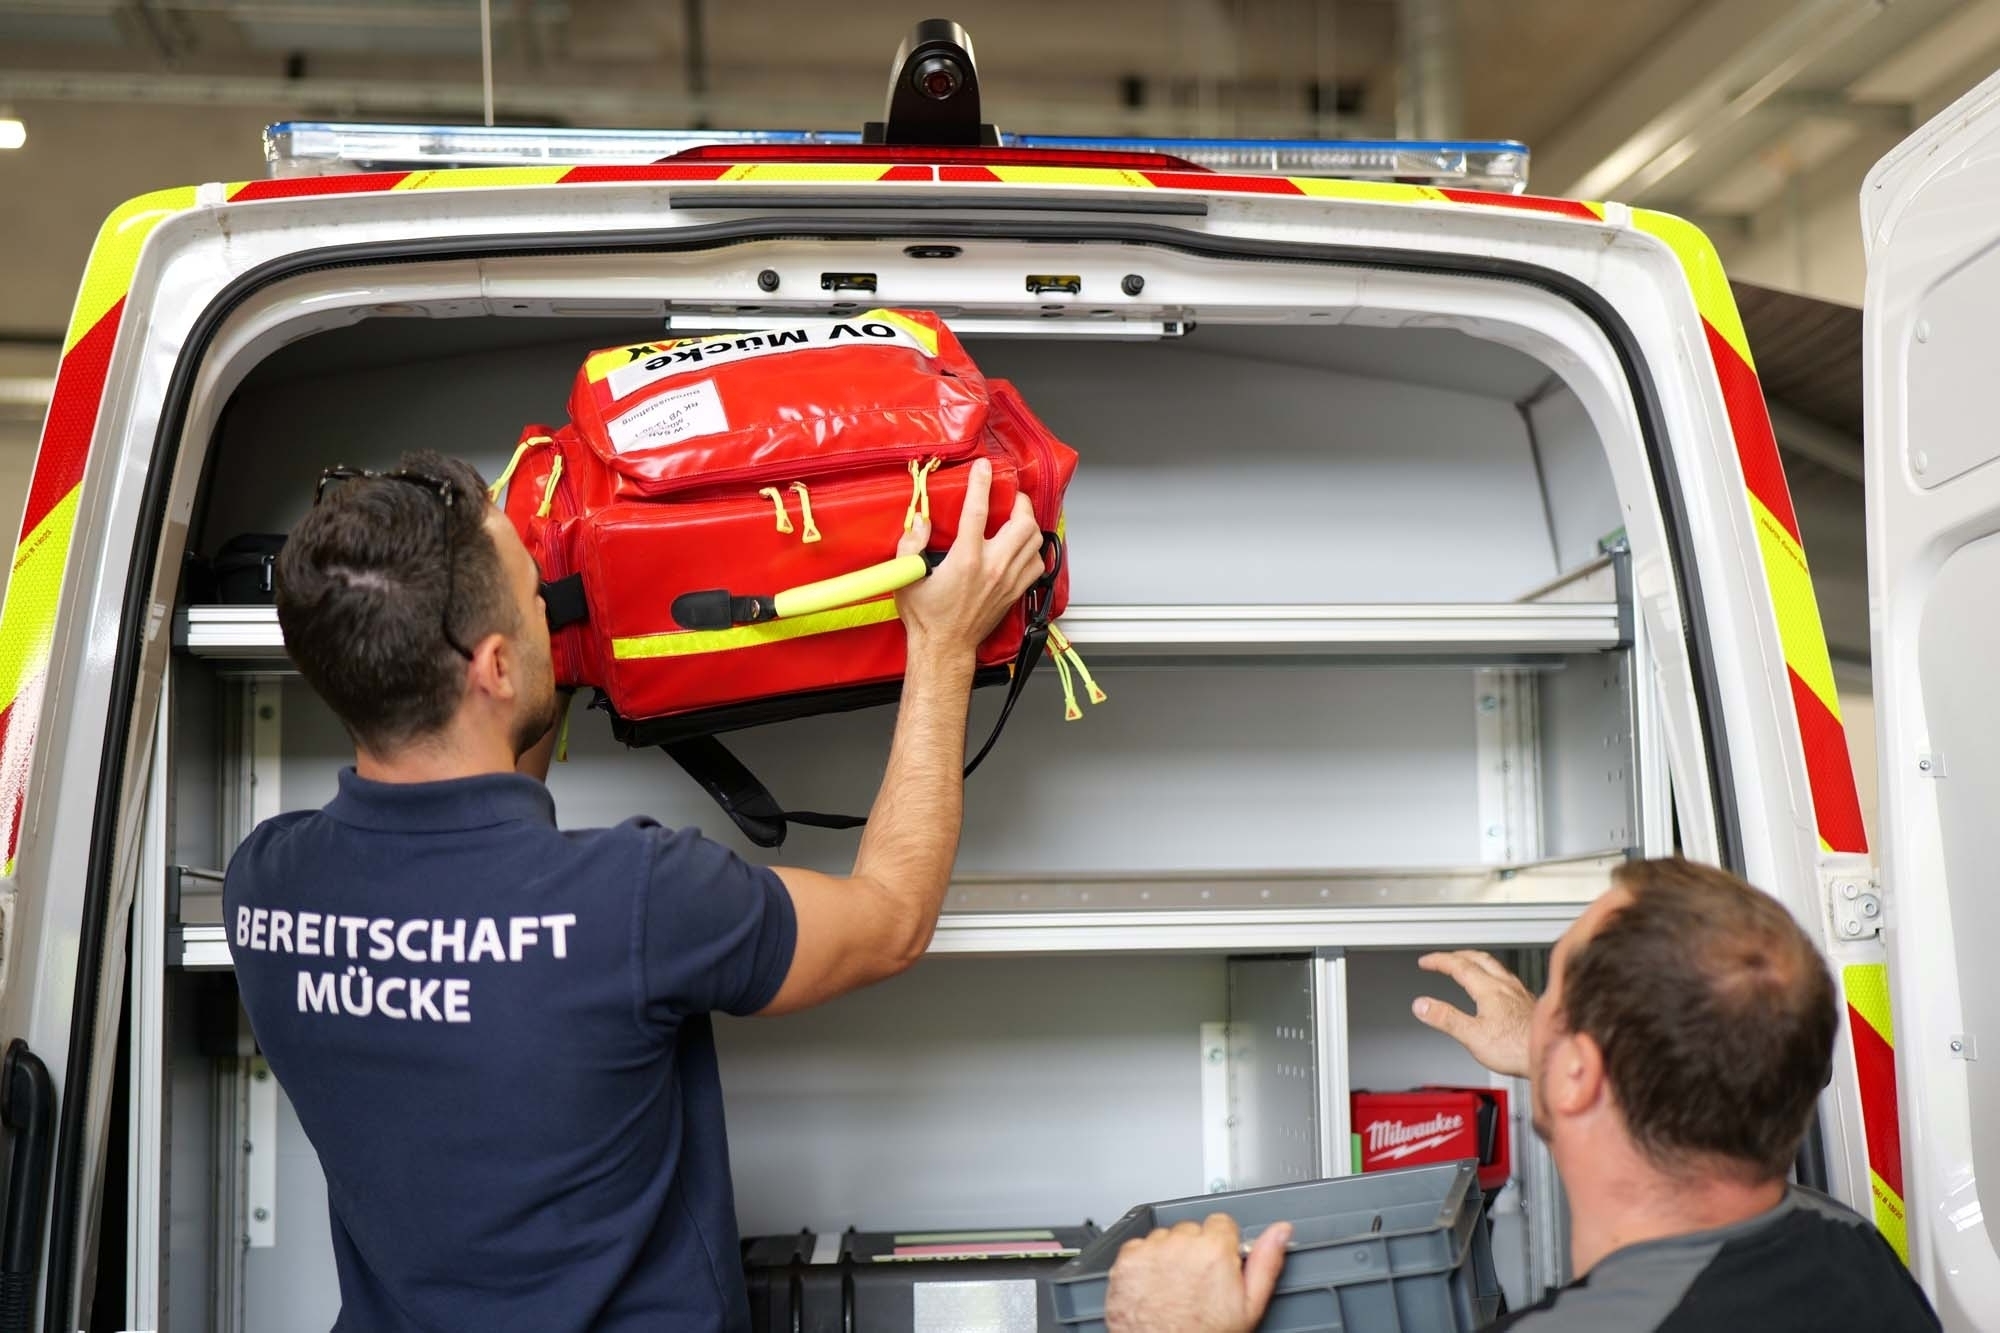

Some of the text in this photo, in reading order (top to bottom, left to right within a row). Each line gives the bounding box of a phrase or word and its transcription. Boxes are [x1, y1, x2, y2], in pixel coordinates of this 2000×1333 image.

[645, 323, 897, 371] OV Mücke
[236, 905, 577, 963] BEREITSCHAFT
[297, 965, 471, 1023] MÜCKE
[1364, 1112, 1464, 1152] Milwaukee
